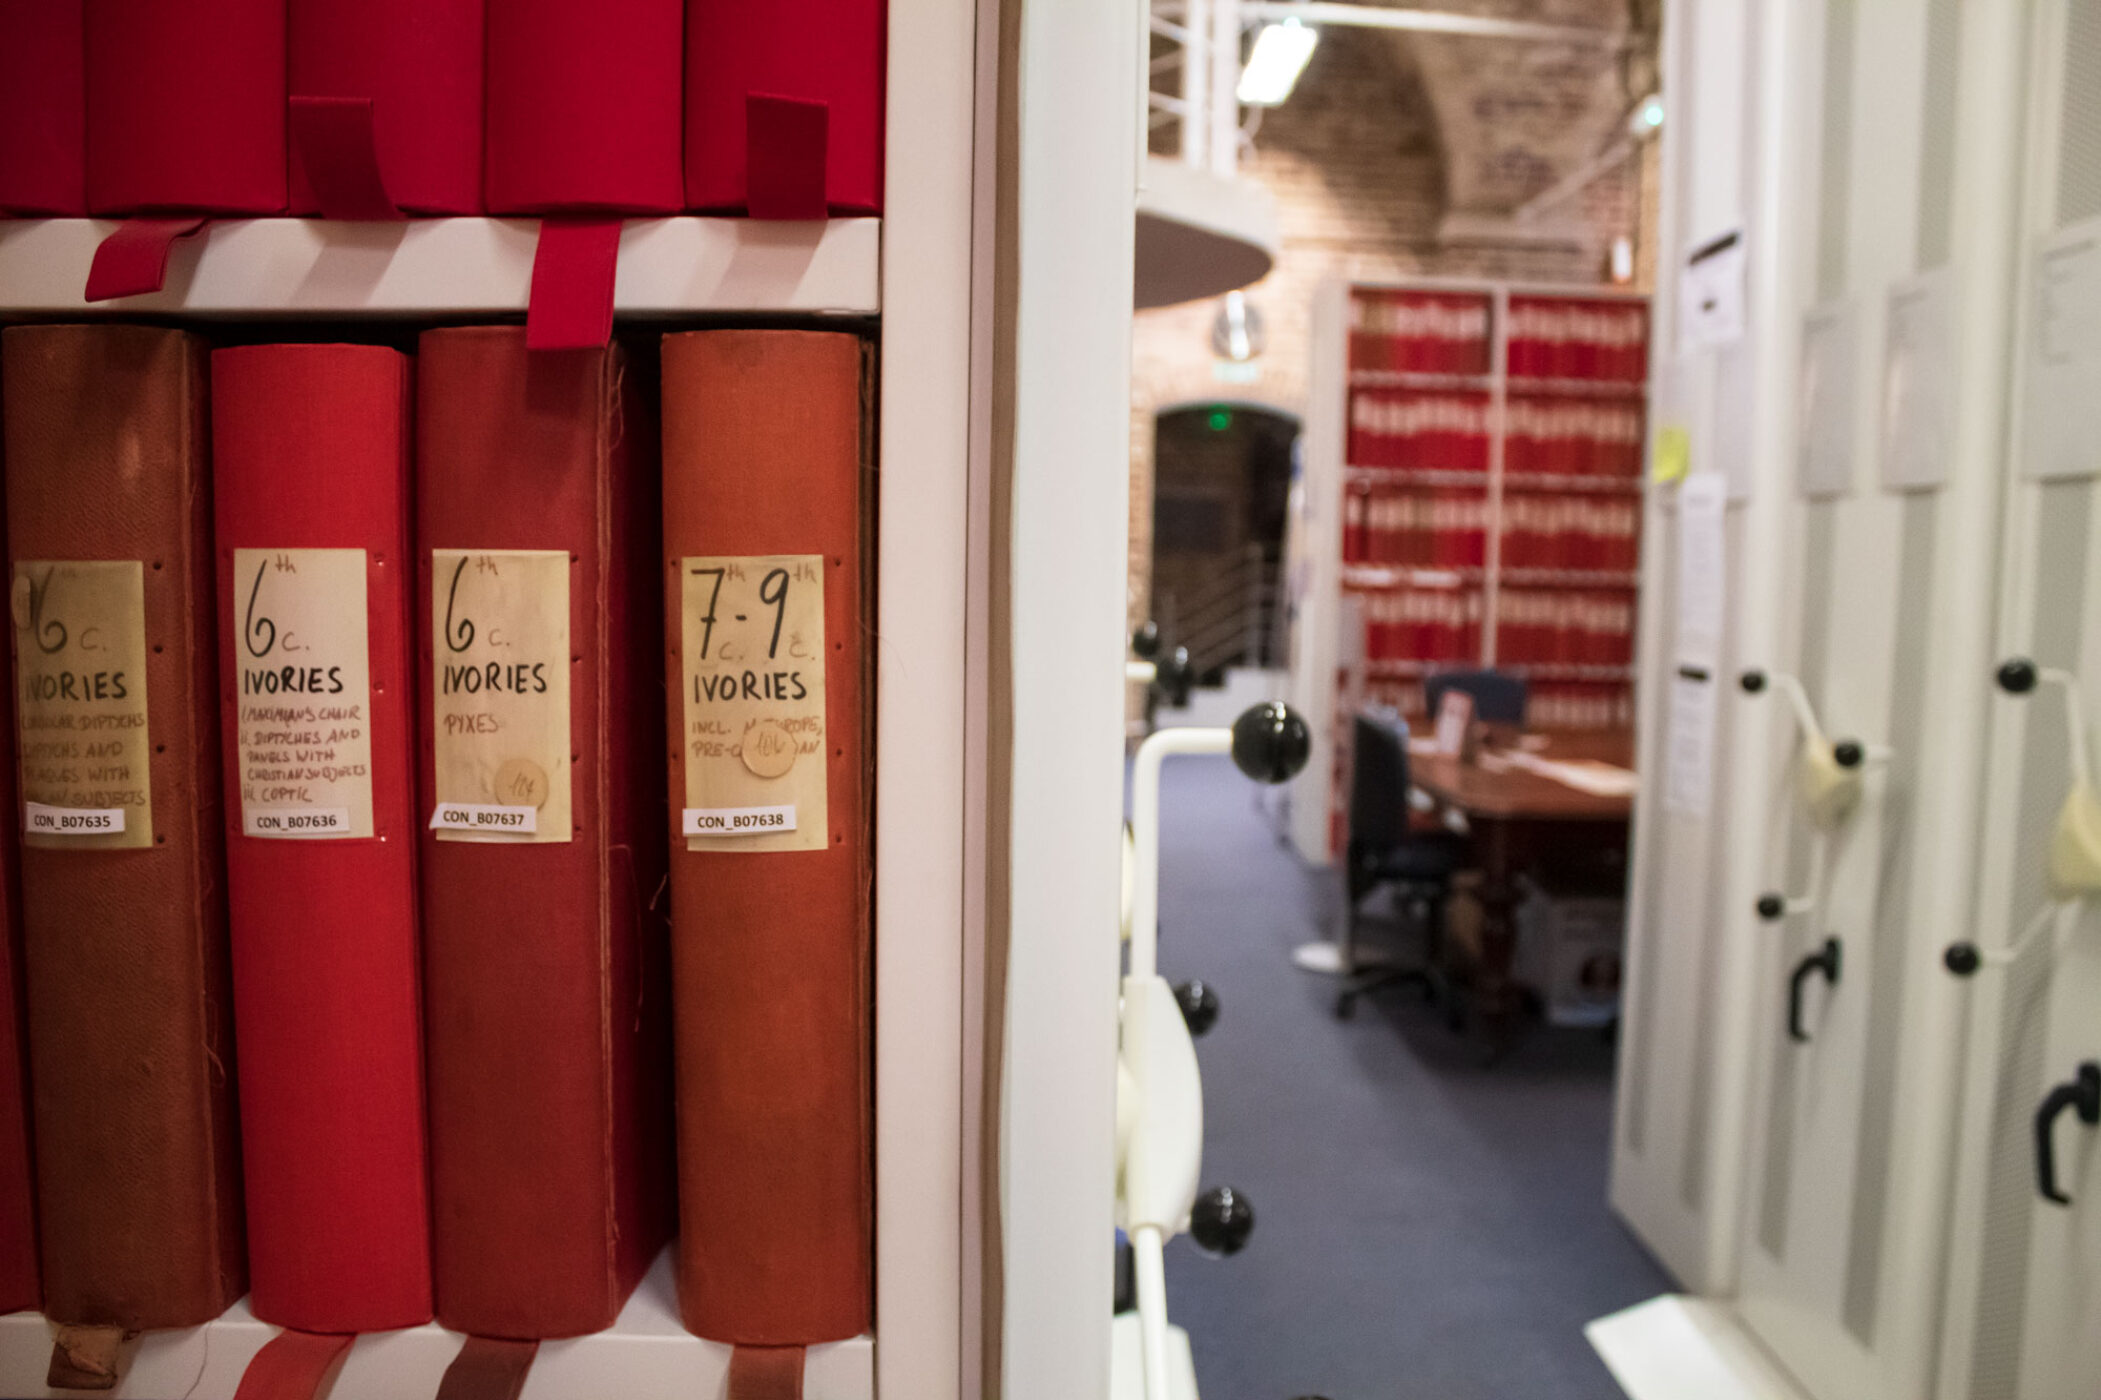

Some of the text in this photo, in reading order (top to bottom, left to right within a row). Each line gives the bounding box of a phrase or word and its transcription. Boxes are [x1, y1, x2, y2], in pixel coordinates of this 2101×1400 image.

[245, 666, 343, 695] IVORIES
[443, 661, 547, 695] IVORIES
[25, 672, 128, 701] IVORIES
[695, 670, 807, 704] IVORIES
[319, 705, 361, 721] CHAIR
[443, 713, 499, 735] PYXES
[691, 721, 732, 735] INCL.
[327, 729, 361, 744] AND
[86, 741, 123, 759] AND
[296, 748, 336, 763] WITH
[88, 766, 130, 782] WITH
[248, 768, 304, 782] CHRISTIAN
[71, 789, 146, 808] SUBJECTS
[262, 786, 313, 802] COPTIC
[34, 814, 111, 830] CON_B07635
[257, 815, 337, 831] CON_B07636
[443, 810, 525, 826] CON_B07637
[697, 814, 784, 831] CON_B07638
